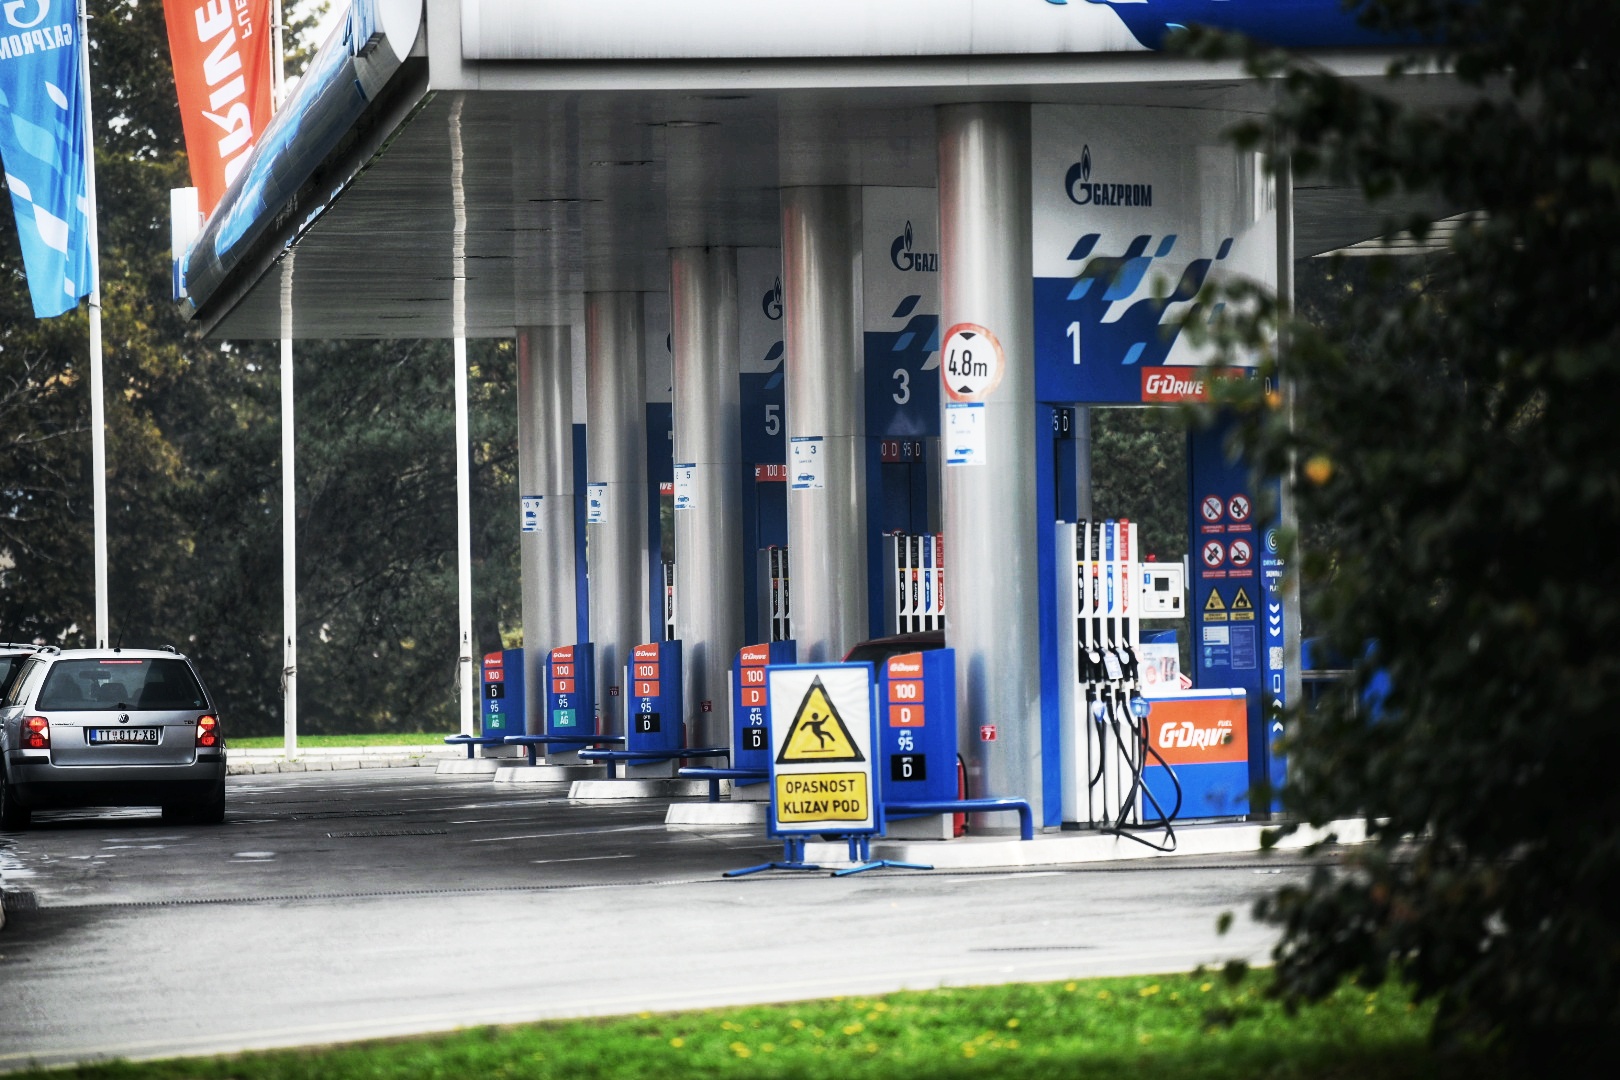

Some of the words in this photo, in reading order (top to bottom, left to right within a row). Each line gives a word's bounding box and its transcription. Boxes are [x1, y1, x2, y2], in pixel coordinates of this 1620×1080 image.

[1093, 183, 1153, 207] GAZPROM
[1066, 321, 1081, 365] 1
[892, 368, 910, 404] 3
[764, 404, 780, 436] 5
[1063, 416, 1069, 431] D
[811, 445, 816, 454] 3
[891, 442, 897, 456] D
[903, 442, 911, 456] 95
[915, 442, 920, 456] D
[766, 465, 777, 476] 100
[488, 672, 499, 680] 100
[556, 666, 569, 675] 100
[639, 665, 653, 676] 100
[746, 670, 763, 682] 100
[560, 681, 566, 691] D
[643, 683, 650, 694] D
[895, 684, 916, 699] 100
[491, 688, 497, 697] D
[751, 690, 759, 703] D
[490, 703, 499, 713] 95
[558, 698, 568, 708] 95
[640, 702, 652, 713] 95
[560, 715, 569, 725] AG
[749, 713, 762, 726] 95
[900, 707, 911, 723] D
[491, 719, 500, 728] AG
[643, 720, 651, 731] D
[1217, 719, 1232, 727] FUEL
[98, 730, 111, 740] TT
[752, 735, 761, 747] D
[897, 736, 914, 751] 95
[902, 763, 913, 777] D
[785, 779, 855, 794] OPASNOST
[783, 800, 829, 814] KLIZAV
[832, 799, 860, 813] POD
